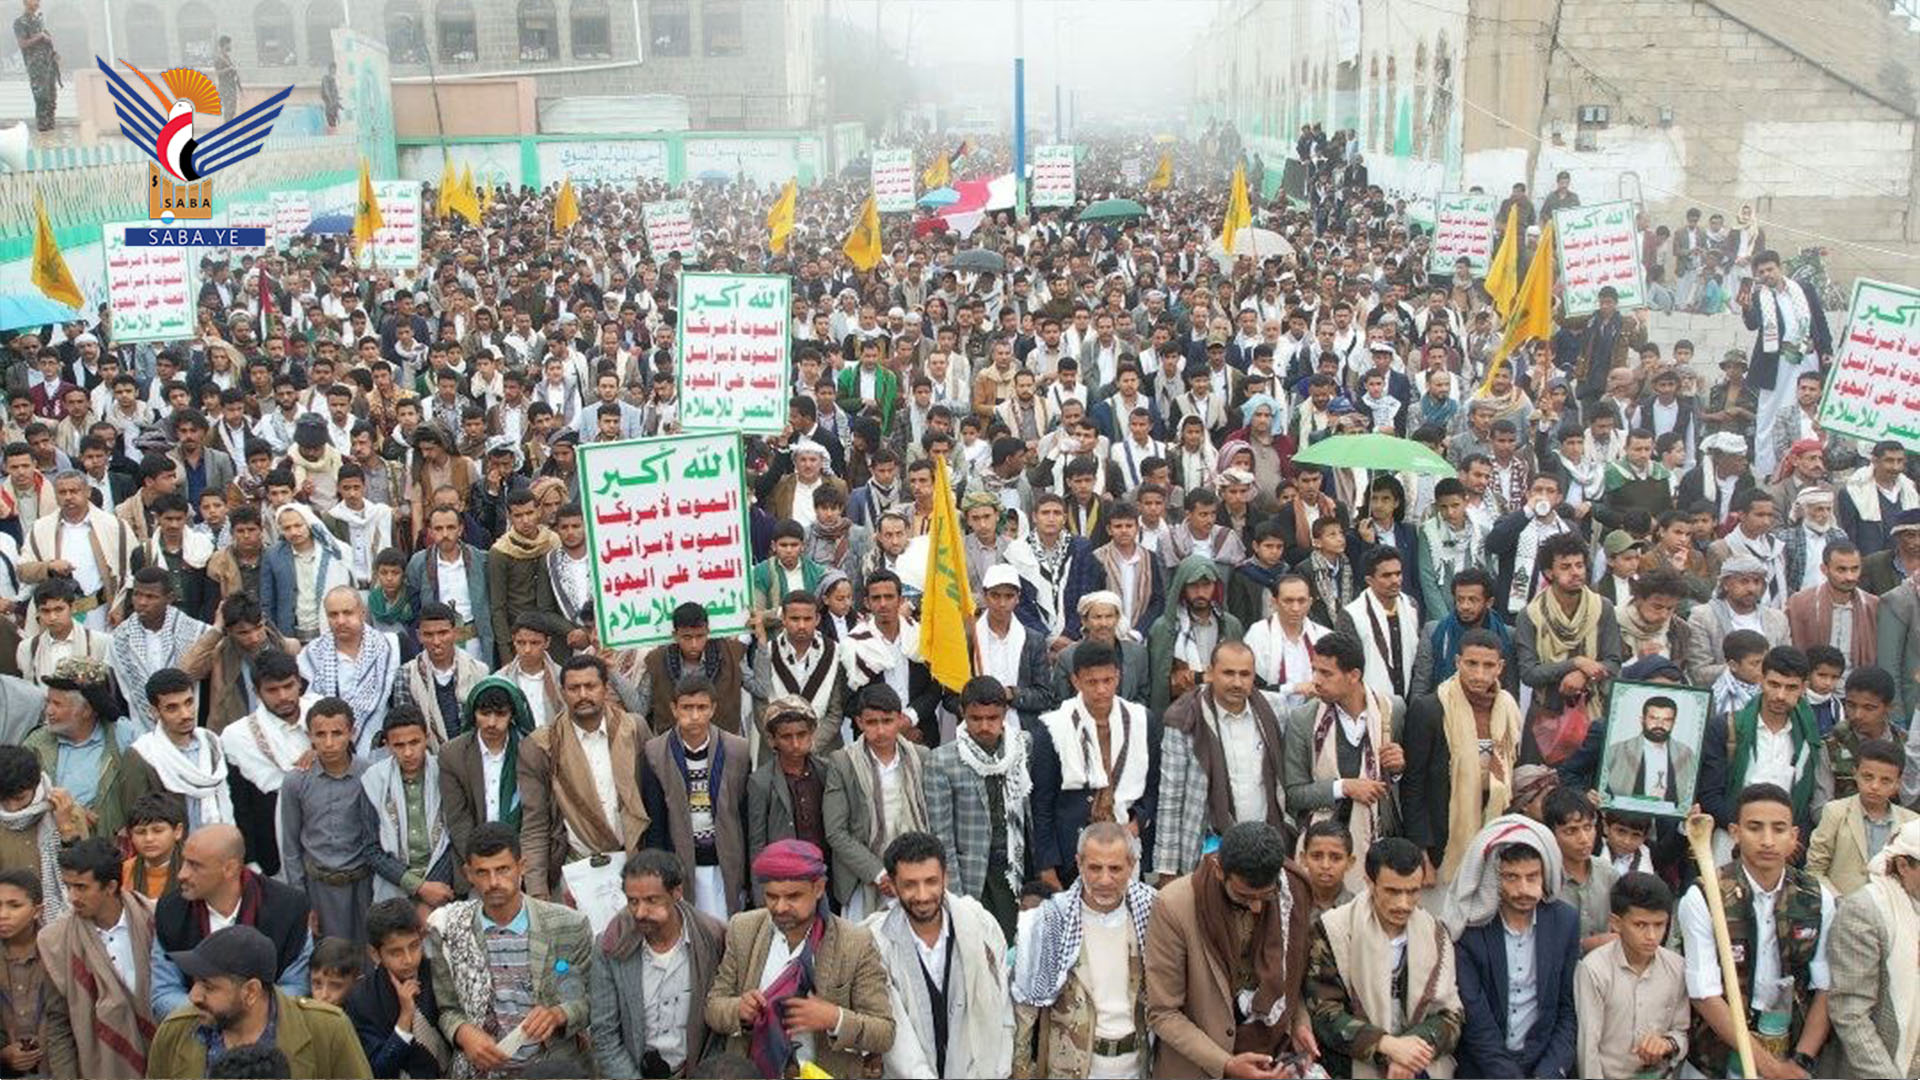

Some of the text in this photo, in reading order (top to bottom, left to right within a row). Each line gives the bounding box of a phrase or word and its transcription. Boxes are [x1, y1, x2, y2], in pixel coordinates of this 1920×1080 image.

[689, 280, 785, 314] الله أكبر
[741, 319, 783, 339] الموت
[741, 347, 783, 366] الموت
[739, 395, 782, 423] النصر
[594, 443, 736, 499] الله أكبر
[595, 489, 738, 528] الموت لأمريكا
[600, 523, 741, 565] الموت لإسرائيل
[603, 556, 743, 597] اللعنة على اليهود
[704, 586, 746, 616] النص
